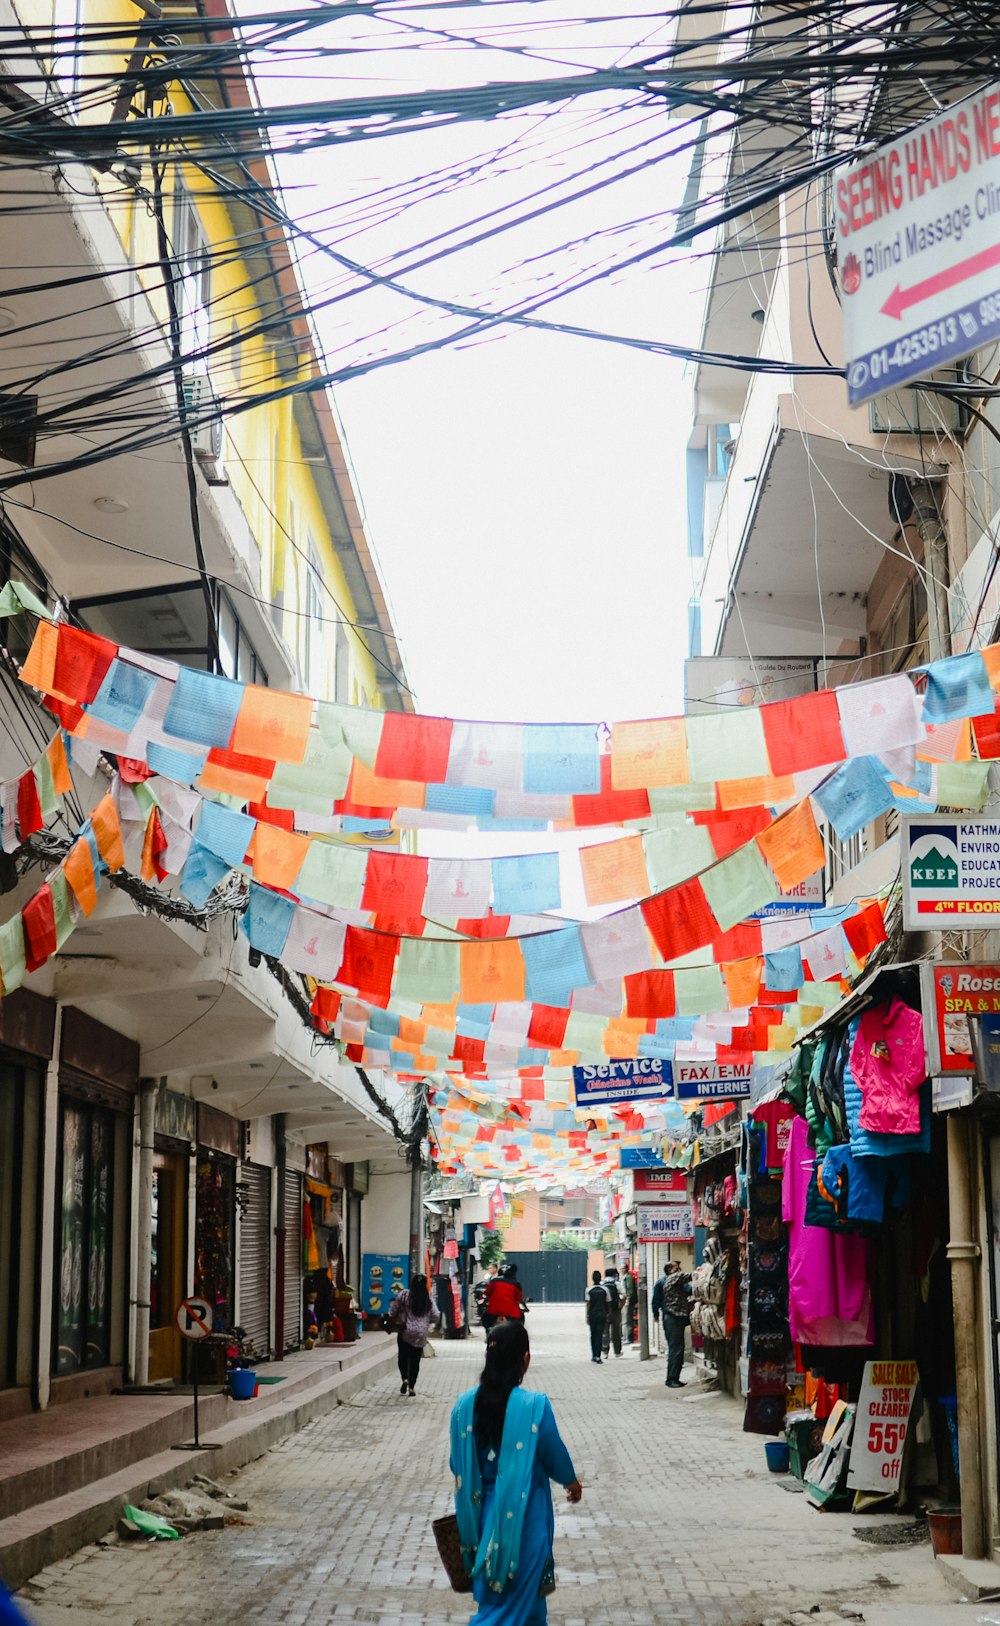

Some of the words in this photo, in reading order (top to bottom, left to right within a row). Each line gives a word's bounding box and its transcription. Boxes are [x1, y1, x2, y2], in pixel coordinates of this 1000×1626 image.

[836, 149, 903, 238] SEEING
[904, 110, 971, 202] HANDS
[972, 90, 1000, 164] NE
[864, 232, 901, 279] Blind
[905, 203, 970, 259] Massage
[870, 317, 958, 378] 01-4253513
[787, 663, 811, 671] Routard
[961, 843, 1000, 853] ENVIRO
[912, 869, 956, 880] KEEP
[934, 902, 954, 912] 4TH
[957, 902, 1000, 913] FLOOR
[945, 998, 974, 1012] SPA
[977, 998, 989, 1011] &
[582, 1058, 663, 1080] Service
[680, 1066, 709, 1081] FAX
[606, 1089, 640, 1097] INSIDE
[650, 1173, 672, 1181] IME
[651, 1219, 680, 1231] MONEY
[882, 1387, 910, 1402] STOCK
[881, 1458, 900, 1479] off
